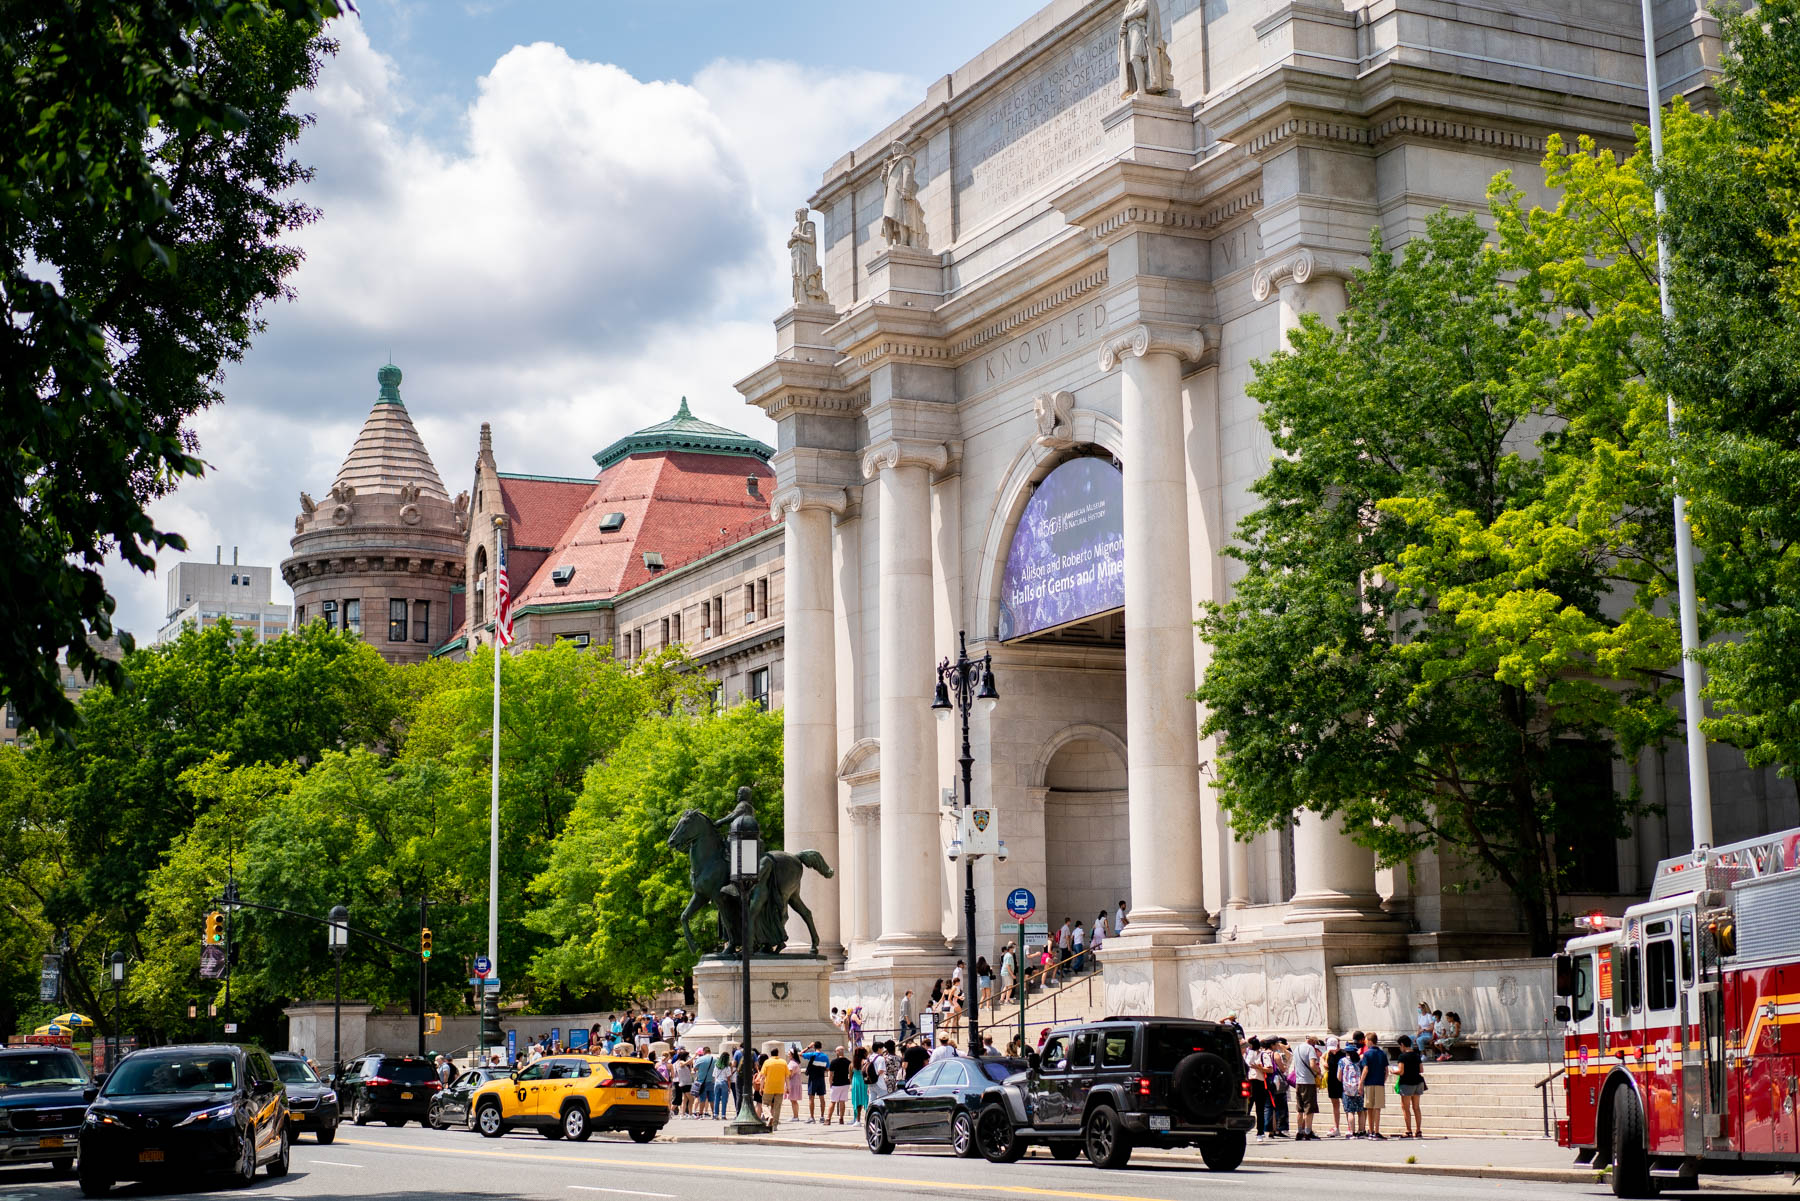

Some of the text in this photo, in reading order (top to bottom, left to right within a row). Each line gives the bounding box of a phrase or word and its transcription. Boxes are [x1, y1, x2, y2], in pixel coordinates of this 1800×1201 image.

[990, 102, 1012, 126] STATE
[1028, 80, 1045, 103] NEW
[1048, 63, 1071, 88] YORK
[1073, 32, 1118, 72] MEMORIAL
[1006, 49, 1115, 133] THEODORE ROOSEVELT
[1065, 508, 1086, 520] AMERICAN
[1086, 500, 1106, 513] MUSEUM
[1069, 516, 1088, 530] NATURAL
[1088, 509, 1106, 522] HISTORY
[1021, 563, 1046, 582] Allison
[1046, 556, 1060, 574] and
[1062, 549, 1092, 569] Roberto
[1012, 584, 1035, 606] Halls
[1036, 579, 1047, 599] of
[1047, 574, 1075, 595] Gems
[1076, 563, 1095, 586] and
[1655, 1039, 1672, 1075] 25
